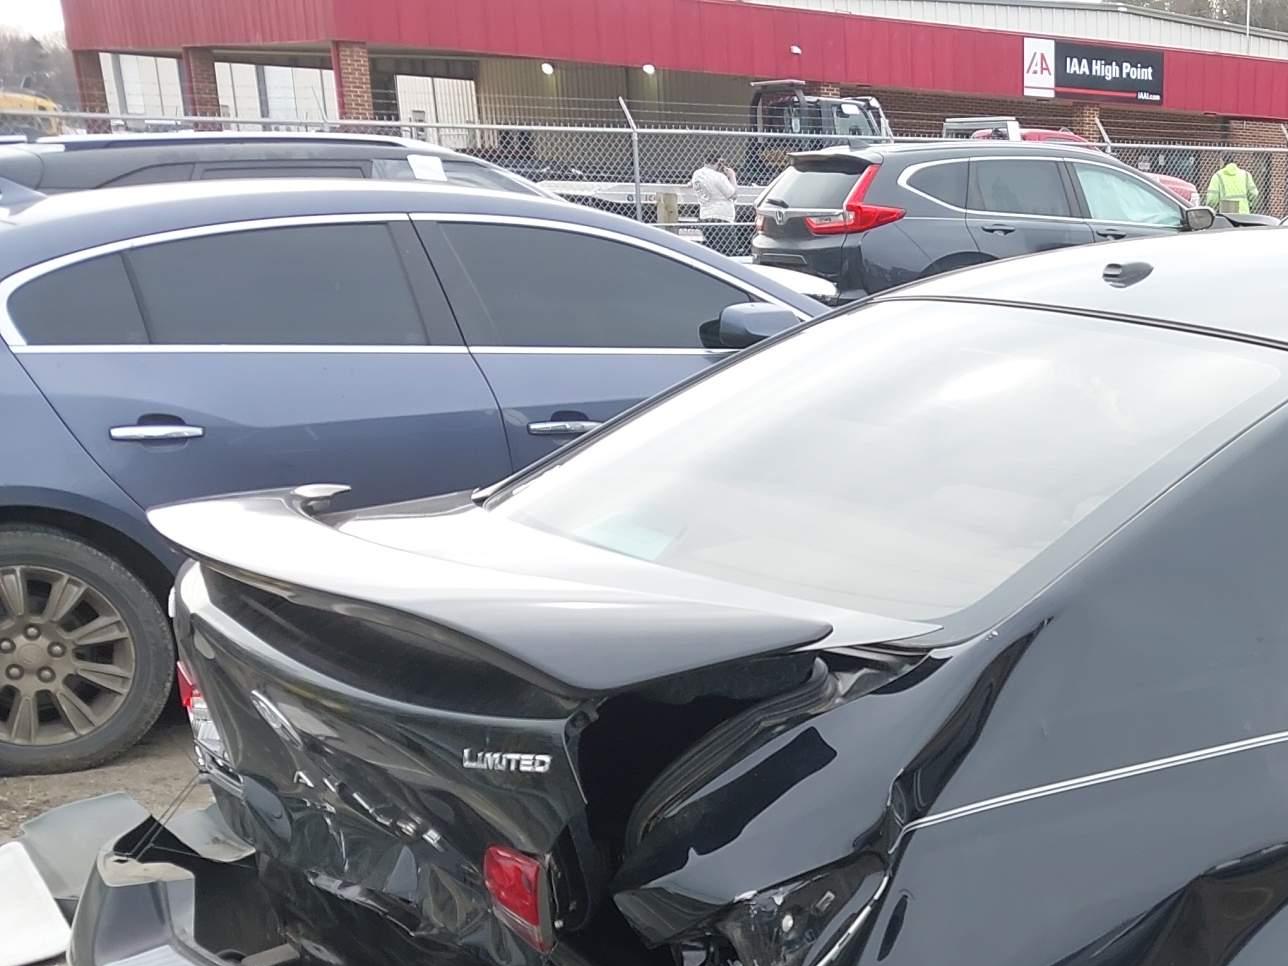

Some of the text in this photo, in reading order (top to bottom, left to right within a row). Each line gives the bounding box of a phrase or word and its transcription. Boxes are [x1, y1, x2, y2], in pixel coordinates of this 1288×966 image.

[1066, 56, 1153, 81] IAA High Point
[462, 748, 552, 773] LIMITED
